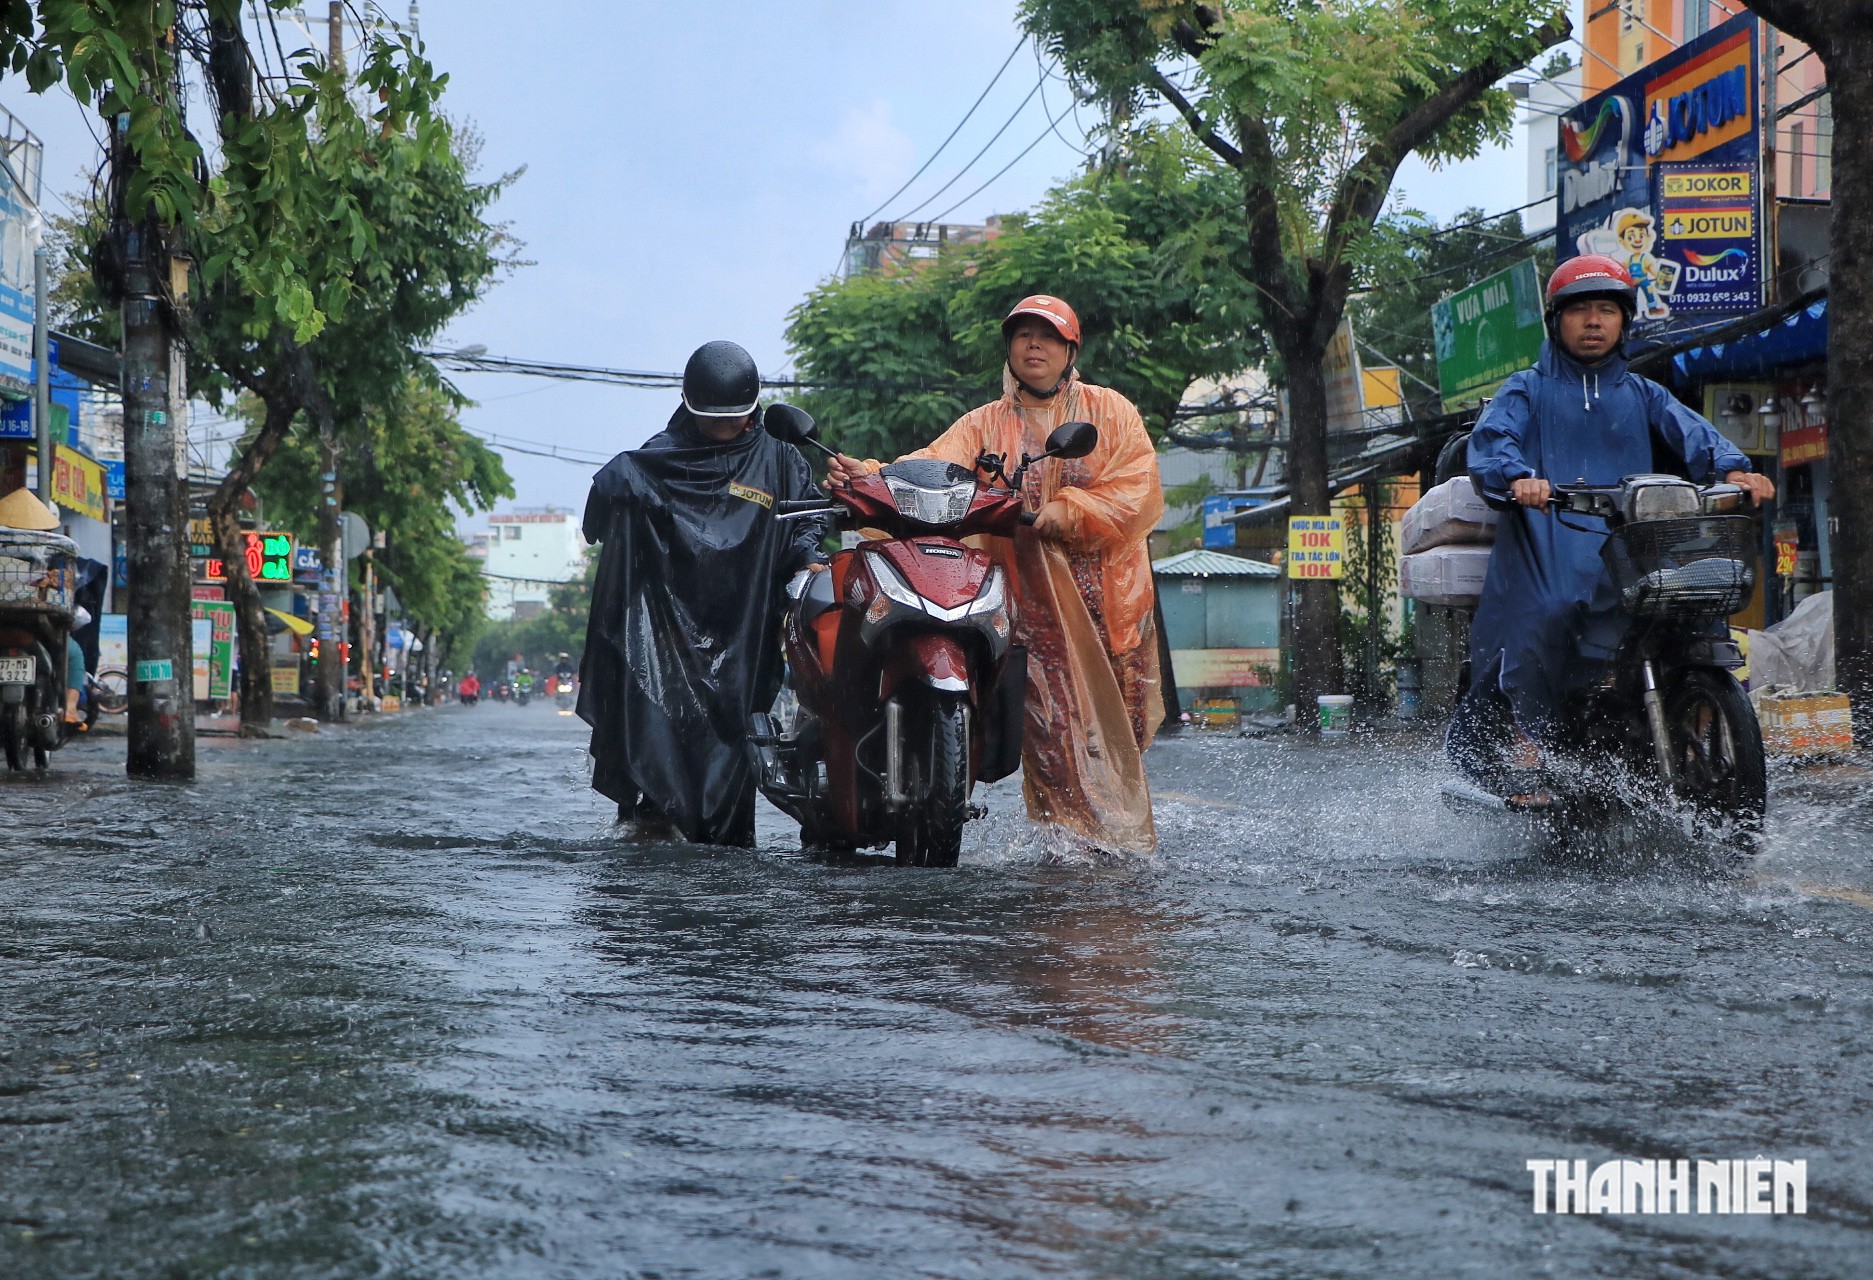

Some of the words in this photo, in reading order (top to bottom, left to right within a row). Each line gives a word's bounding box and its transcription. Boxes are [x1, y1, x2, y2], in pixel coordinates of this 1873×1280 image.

[1664, 65, 1746, 149] JOTUN
[1686, 177, 1742, 191] JOKOR
[1688, 217, 1747, 233] JOTUN
[1575, 271, 1611, 280] HONDA
[1685, 266, 1740, 282] Dulux
[1687, 292, 1710, 303] 0932
[8, 420, 29, 432] 16-18
[740, 488, 772, 507] JOTUN
[1300, 533, 1331, 546] 10K
[924, 548, 959, 557] HONDA
[1299, 564, 1332, 577] 10K
